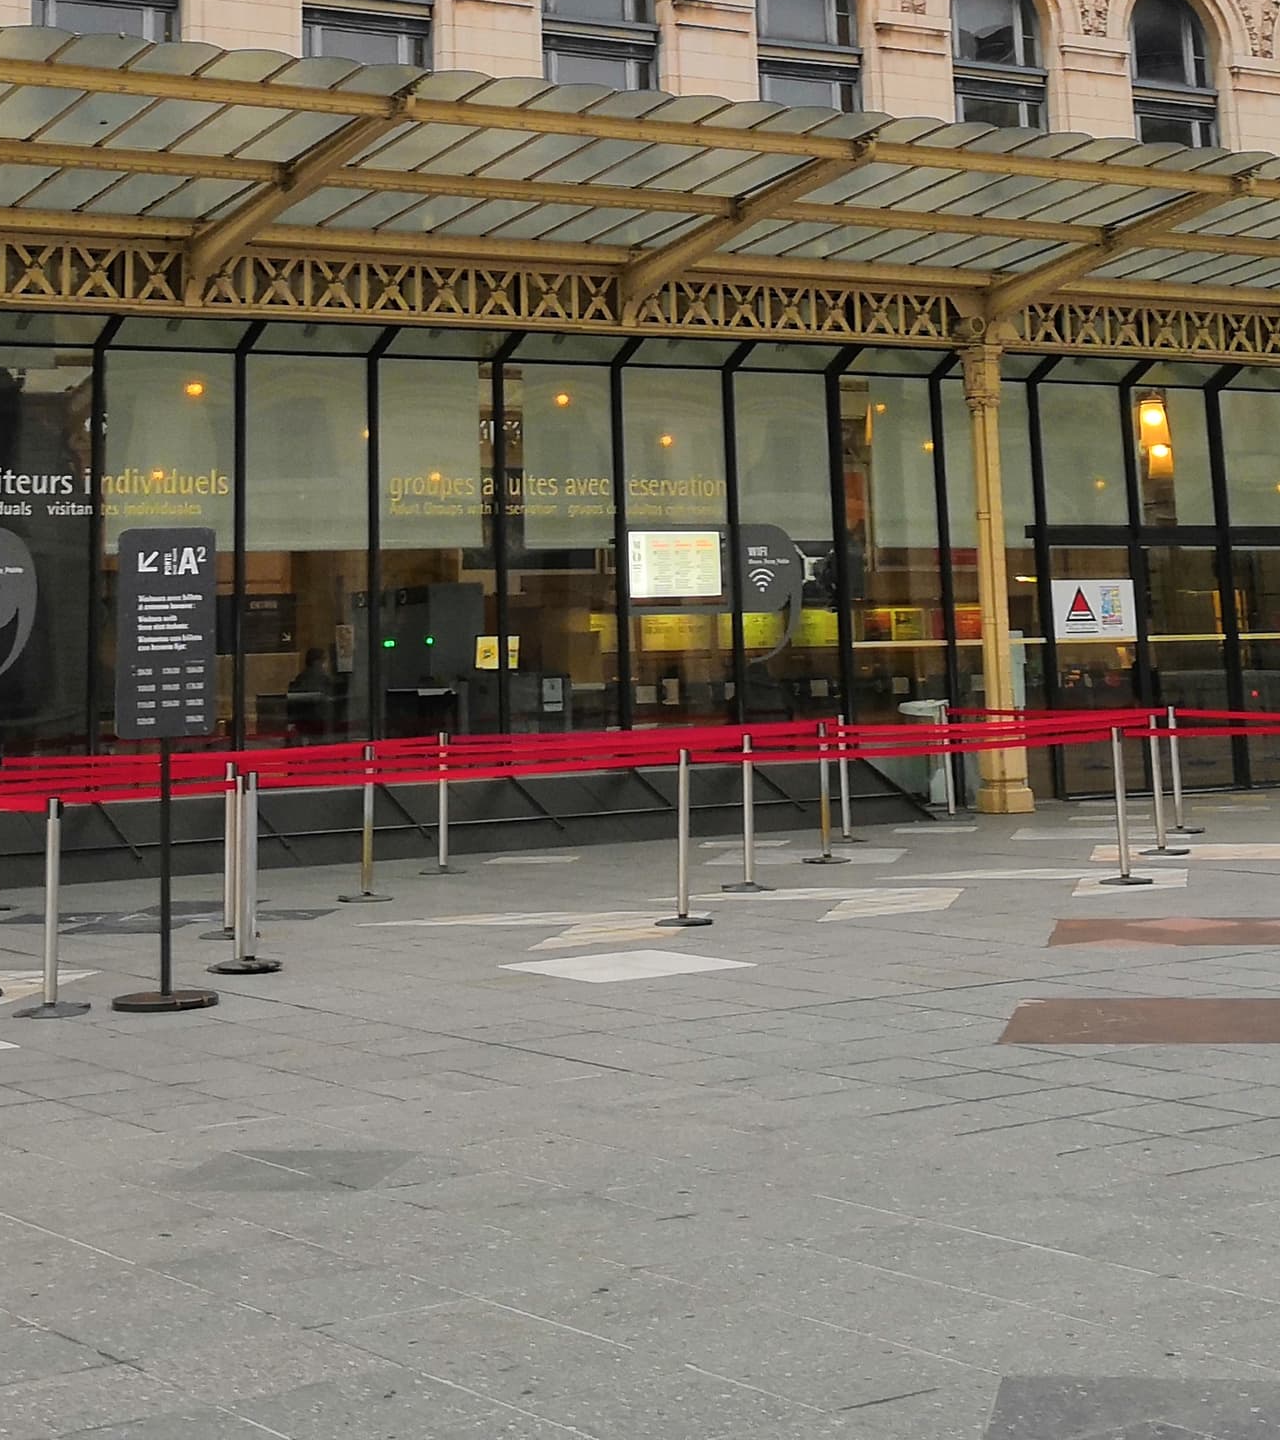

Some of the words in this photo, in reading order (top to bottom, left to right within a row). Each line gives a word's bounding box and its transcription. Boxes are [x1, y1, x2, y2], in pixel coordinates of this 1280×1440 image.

[84, 468, 229, 495] individuels
[389, 477, 474, 502] groupes
[565, 477, 610, 497] avec
[628, 476, 727, 498] éservation
